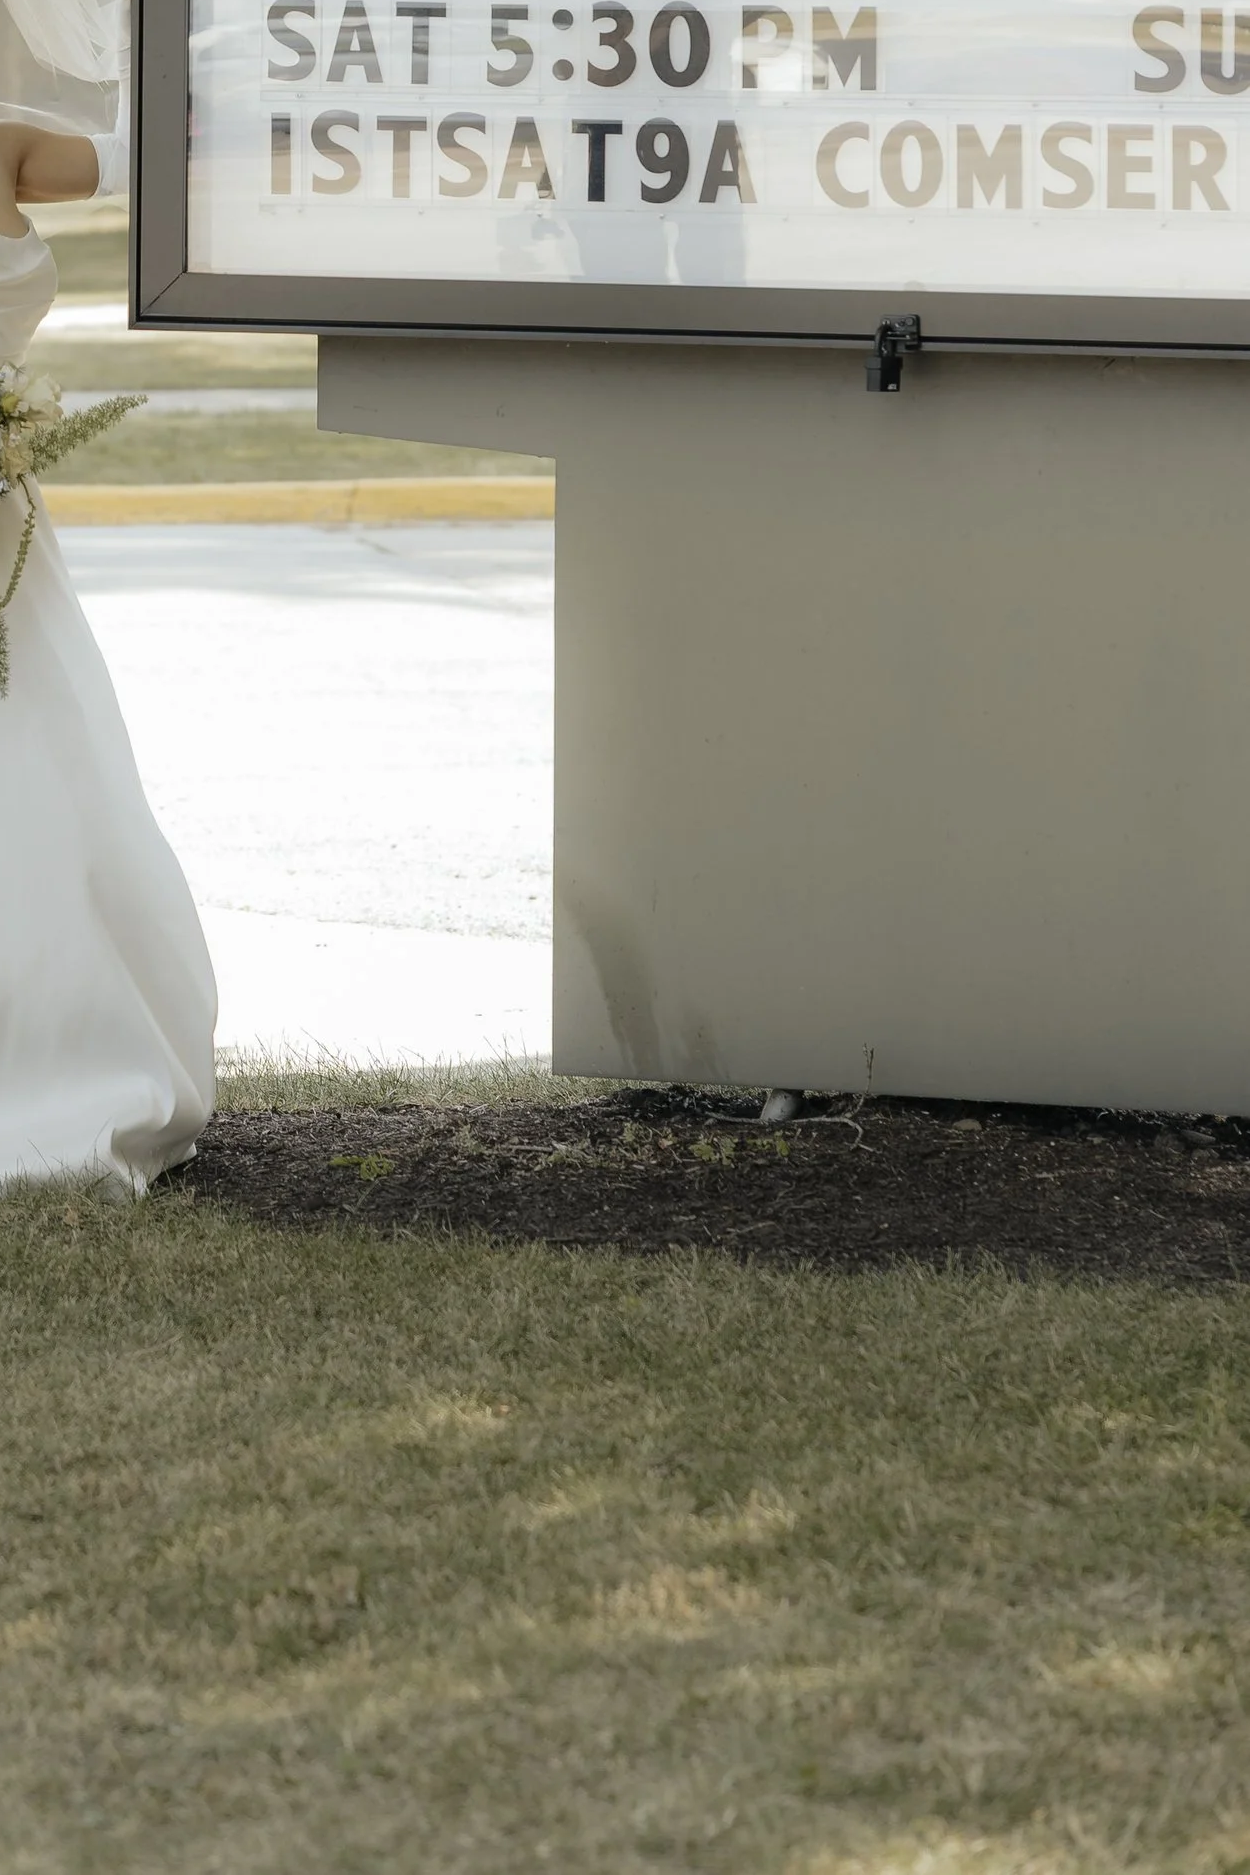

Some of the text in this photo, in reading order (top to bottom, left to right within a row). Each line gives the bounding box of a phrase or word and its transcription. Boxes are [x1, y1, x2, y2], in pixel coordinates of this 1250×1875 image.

[486, 0, 711, 88] 5:30
[742, 5, 877, 91] PM
[816, 121, 1231, 211] COMSER
